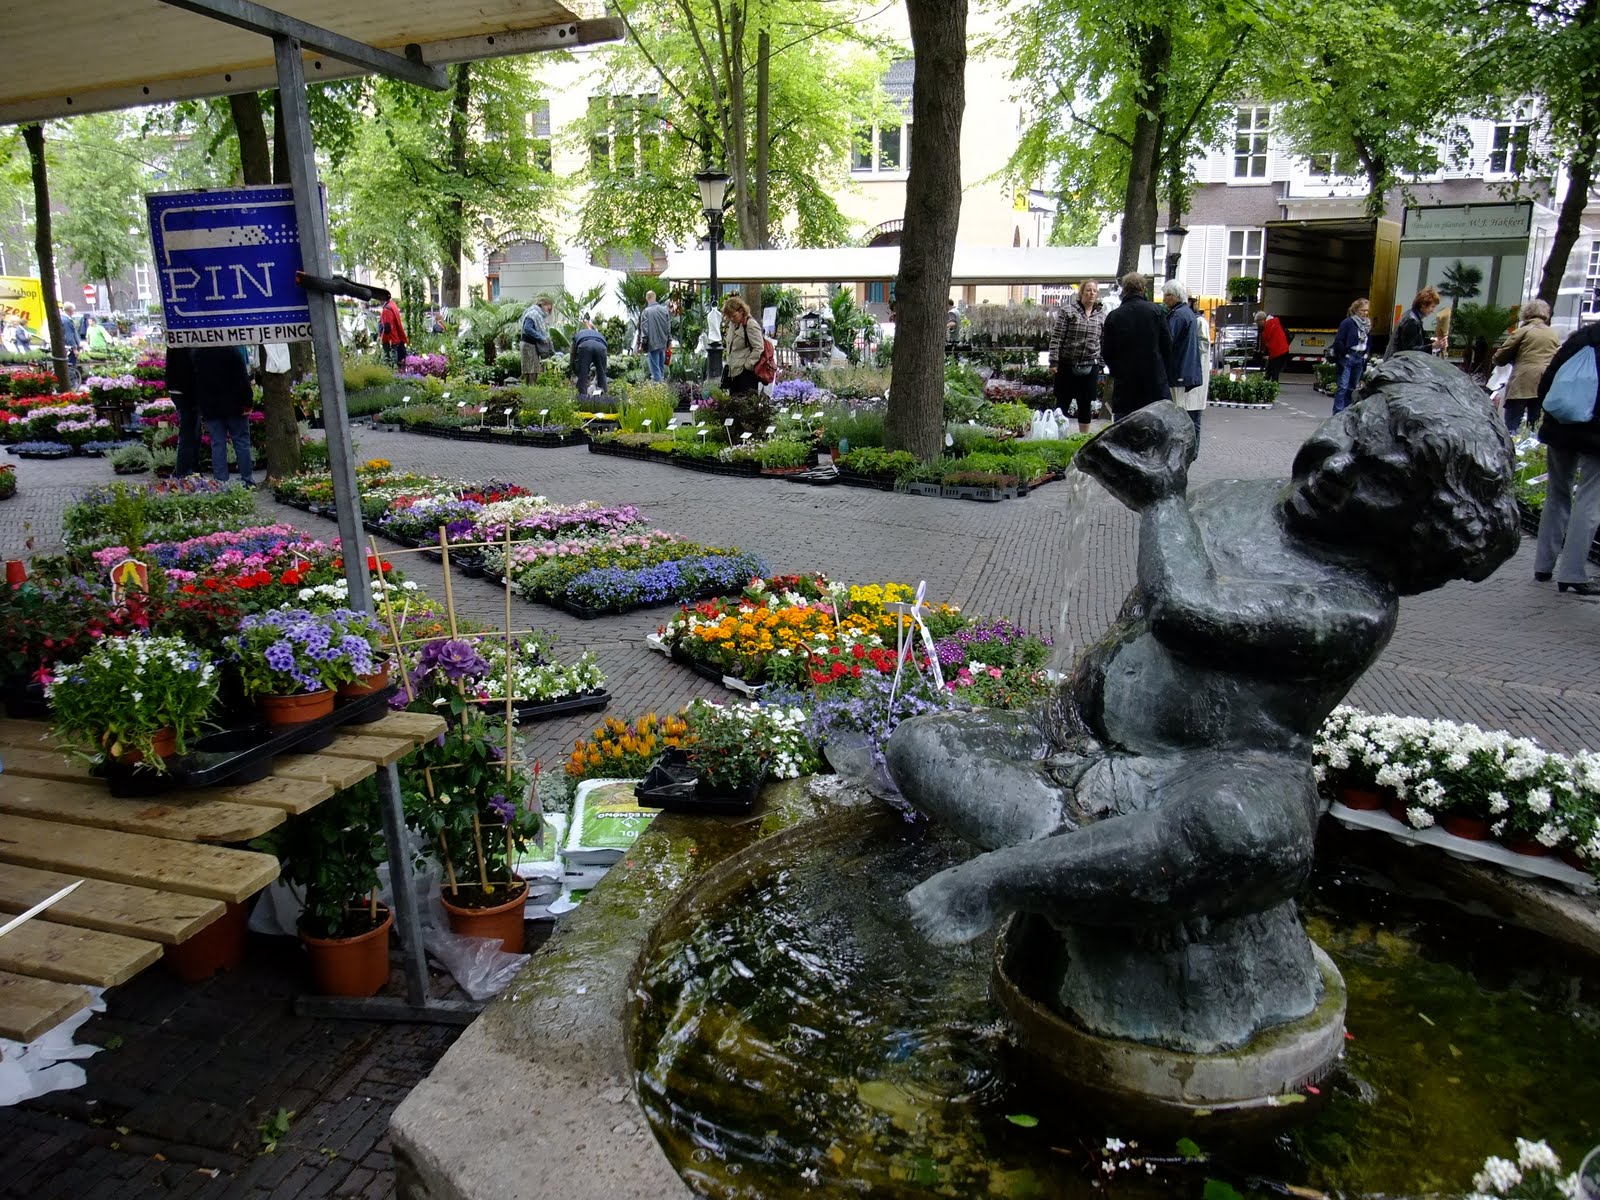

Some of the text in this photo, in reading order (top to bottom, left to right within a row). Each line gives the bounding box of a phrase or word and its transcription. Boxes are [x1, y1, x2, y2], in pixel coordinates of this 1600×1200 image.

[1490, 217, 1525, 228] Hakkert
[162, 261, 276, 303] PIN
[167, 329, 224, 344] BETALEN
[227, 327, 255, 342] MET
[259, 326, 272, 342] JE
